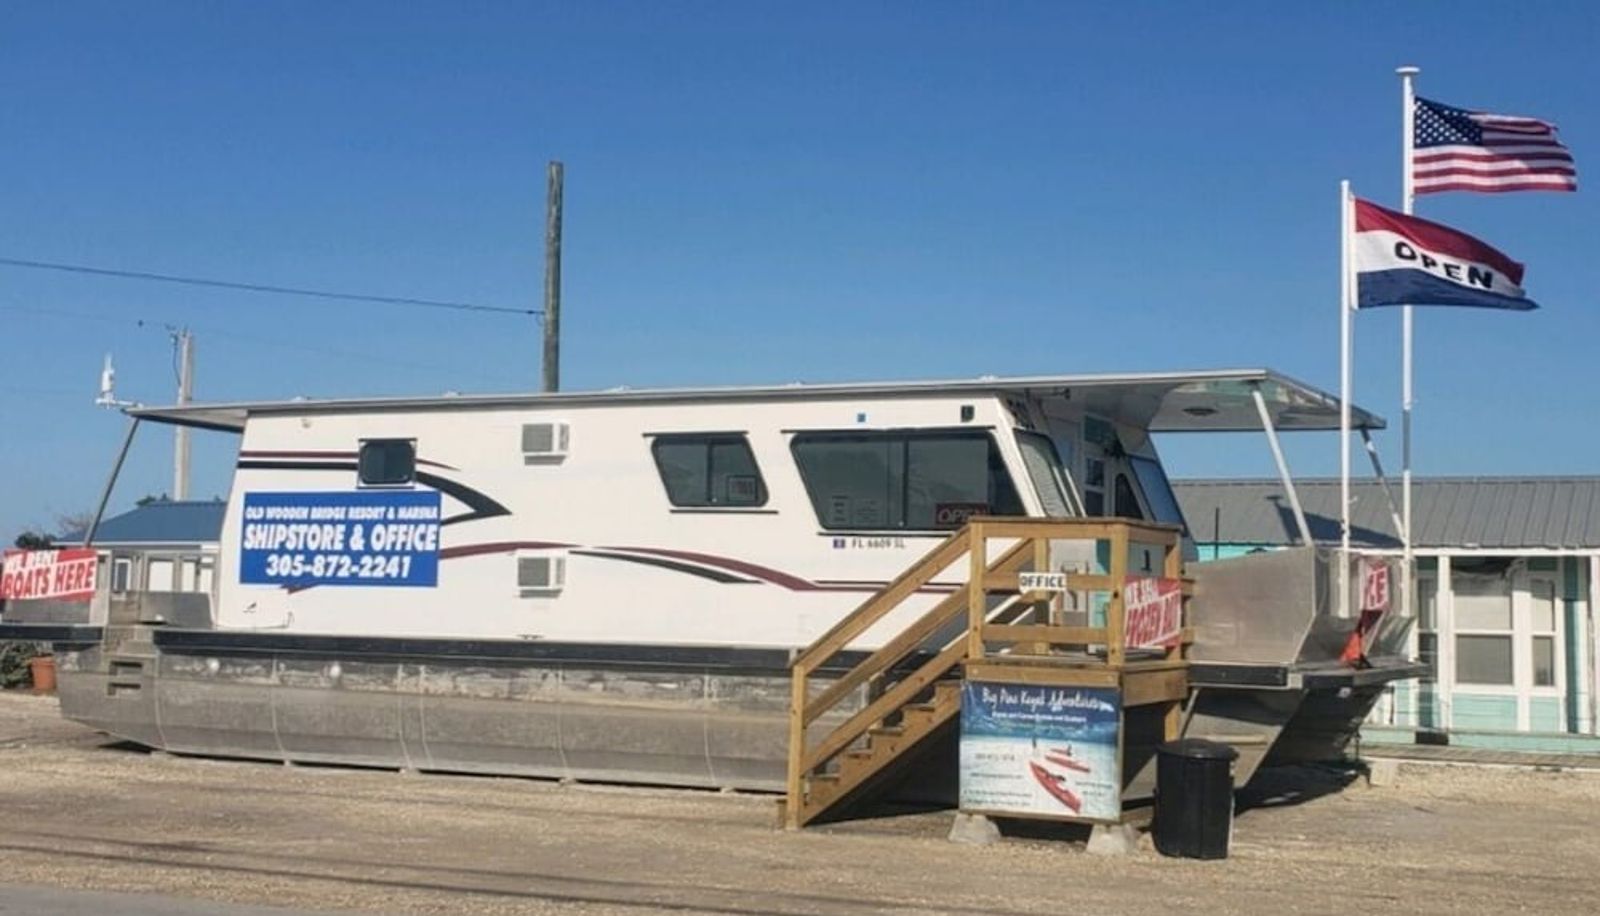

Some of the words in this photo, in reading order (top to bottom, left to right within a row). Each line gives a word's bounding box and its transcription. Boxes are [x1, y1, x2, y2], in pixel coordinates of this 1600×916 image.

[1395, 241, 1493, 289] OPEN
[245, 507, 264, 519] OLD
[266, 507, 309, 519] WOODEN
[310, 507, 347, 519] BRIDGE
[348, 507, 386, 519] RESORT
[387, 507, 395, 520] &
[397, 507, 438, 519] MARINA
[244, 523, 346, 550] SHIPSTORE
[349, 524, 364, 550] &
[371, 524, 438, 551] OFFICE
[3, 567, 50, 598] BOATS
[53, 560, 95, 592] HERE
[265, 554, 411, 578] 305-872-2241
[1021, 575, 1065, 587] OFFICE
